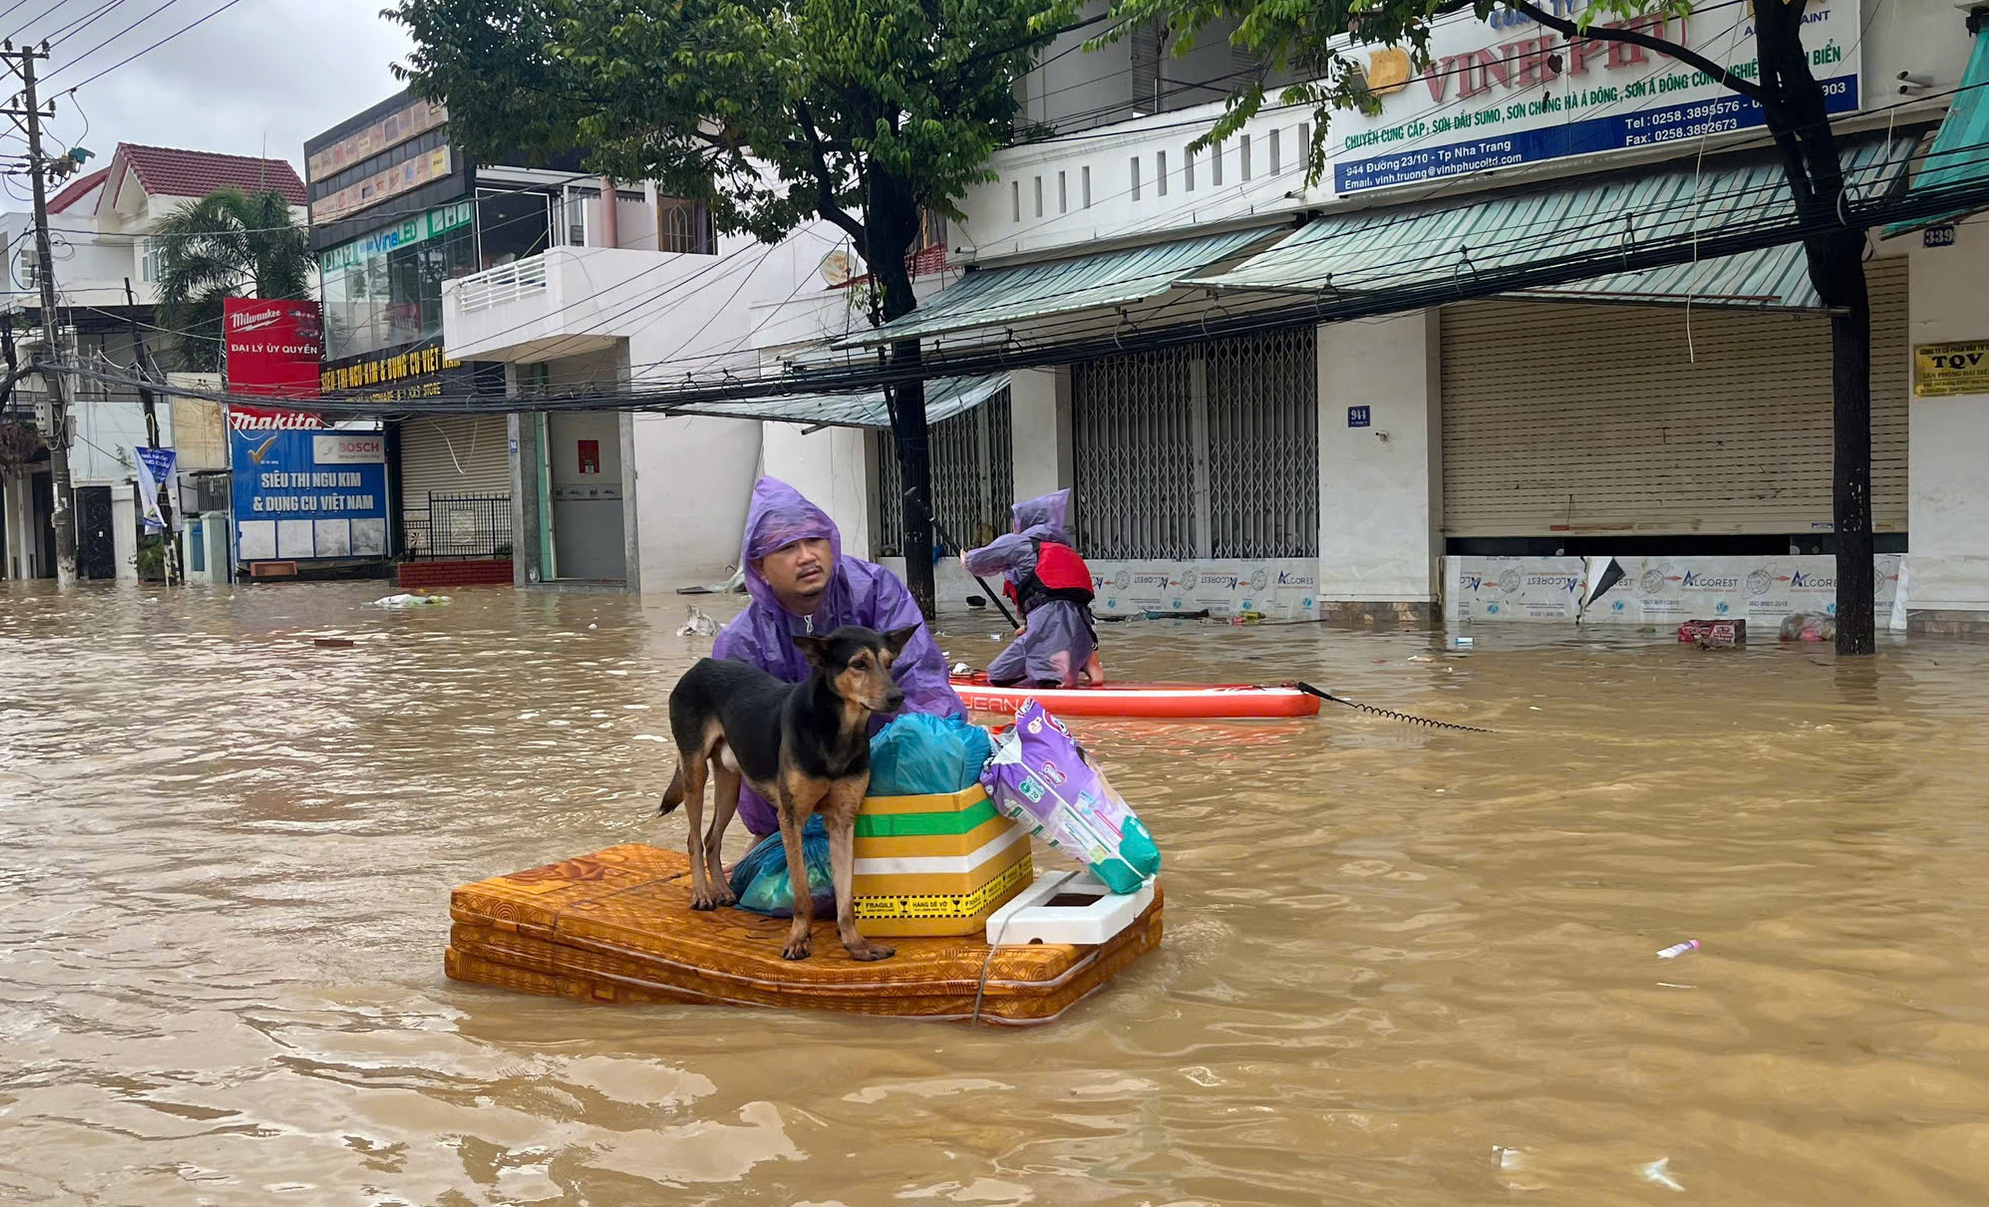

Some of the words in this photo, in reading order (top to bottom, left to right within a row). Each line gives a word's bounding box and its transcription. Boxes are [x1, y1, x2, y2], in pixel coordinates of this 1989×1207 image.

[1800, 10, 1831, 24] AINT
[1423, 34, 1558, 102] VINH
[1345, 129, 1379, 149] CHUYÊN
[1381, 126, 1404, 142] CUNG
[1432, 117, 1450, 132] SƠN
[1507, 102, 1526, 120] SƠN
[1564, 91, 1578, 110] HÀ
[1625, 80, 1646, 99] SƠN
[1659, 73, 1688, 92] ĐÔNG
[1813, 39, 1841, 66] BIỂN
[1652, 101, 1740, 125] 0258.3895576
[1654, 118, 1738, 142] 0258.3892673
[1366, 159, 1400, 173] Đường
[1401, 156, 1428, 167] 23/10
[1438, 151, 1452, 163] Tp
[1454, 147, 1476, 158] Nha
[1478, 140, 1512, 155] Trang
[373, 220, 417, 252] VinaLED
[1926, 229, 1953, 244] 339
[229, 309, 281, 328] Milwaukee
[231, 343, 249, 354] ĐẠI
[365, 361, 379, 385] KIM
[422, 343, 439, 375] VIỆT
[1931, 353, 1984, 370] TQV
[1351, 409, 1367, 420] 944
[338, 442, 379, 452] BOSCH
[261, 470, 289, 488] SIÊU
[290, 472, 310, 490] THỊ
[338, 472, 362, 487] KIM
[253, 497, 264, 511] &
[266, 497, 299, 514] DỤNG
[301, 496, 318, 513] CỤ
[320, 493, 345, 512] VIỆT
[346, 494, 374, 509] NAM
[1527, 577, 1578, 593] ALCOREST
[1682, 570, 1738, 587] ALCOREST
[1790, 570, 1838, 587] ALCORE
[964, 696, 1020, 711] EAN
